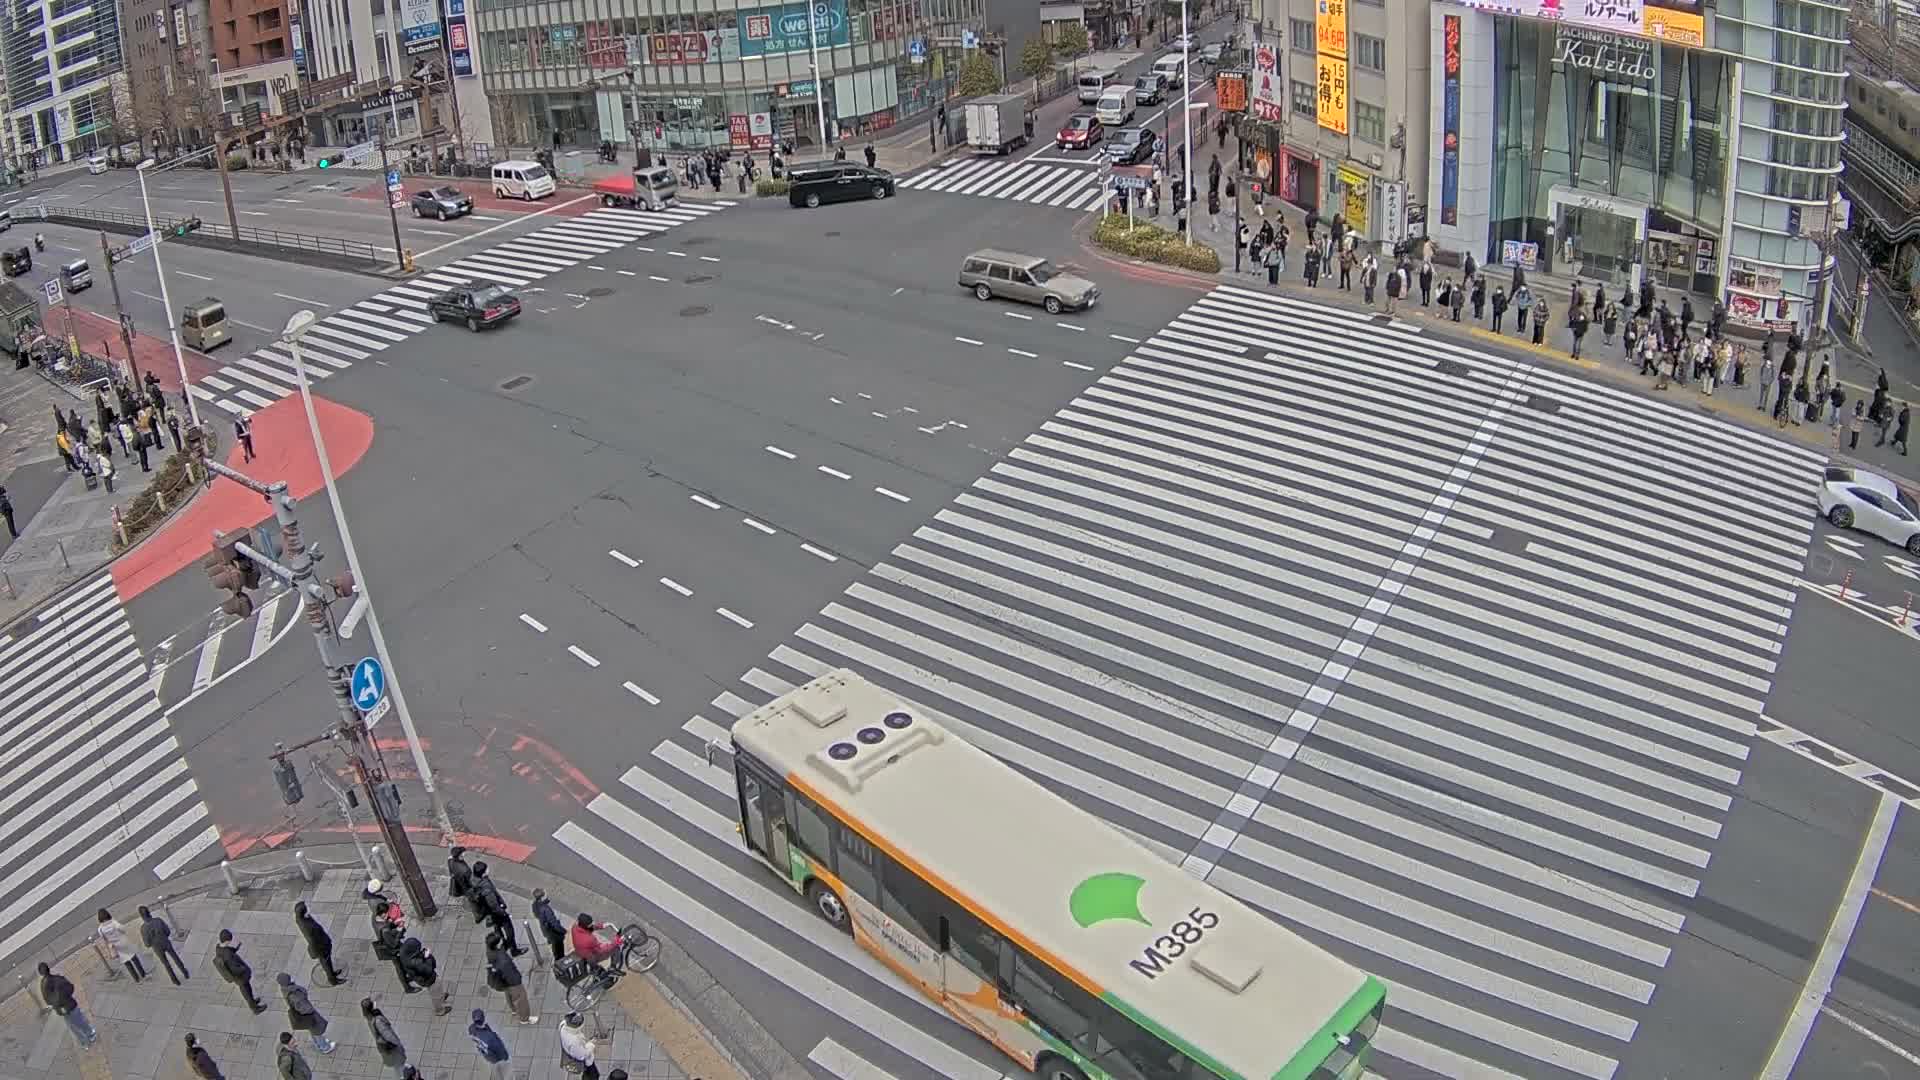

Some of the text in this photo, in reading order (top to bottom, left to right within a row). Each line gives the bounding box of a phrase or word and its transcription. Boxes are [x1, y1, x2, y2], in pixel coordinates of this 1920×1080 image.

[1584, 4, 1640, 24] ルノアール
[764, 34, 828, 50] 処方せん付
[1556, 25, 1612, 44] PACHINKO
[1625, 38, 1650, 51] SLOT
[1551, 38, 1656, 79] Kaleido
[1333, 63, 1345, 110] 15円も
[1129, 907, 1219, 980] M385
